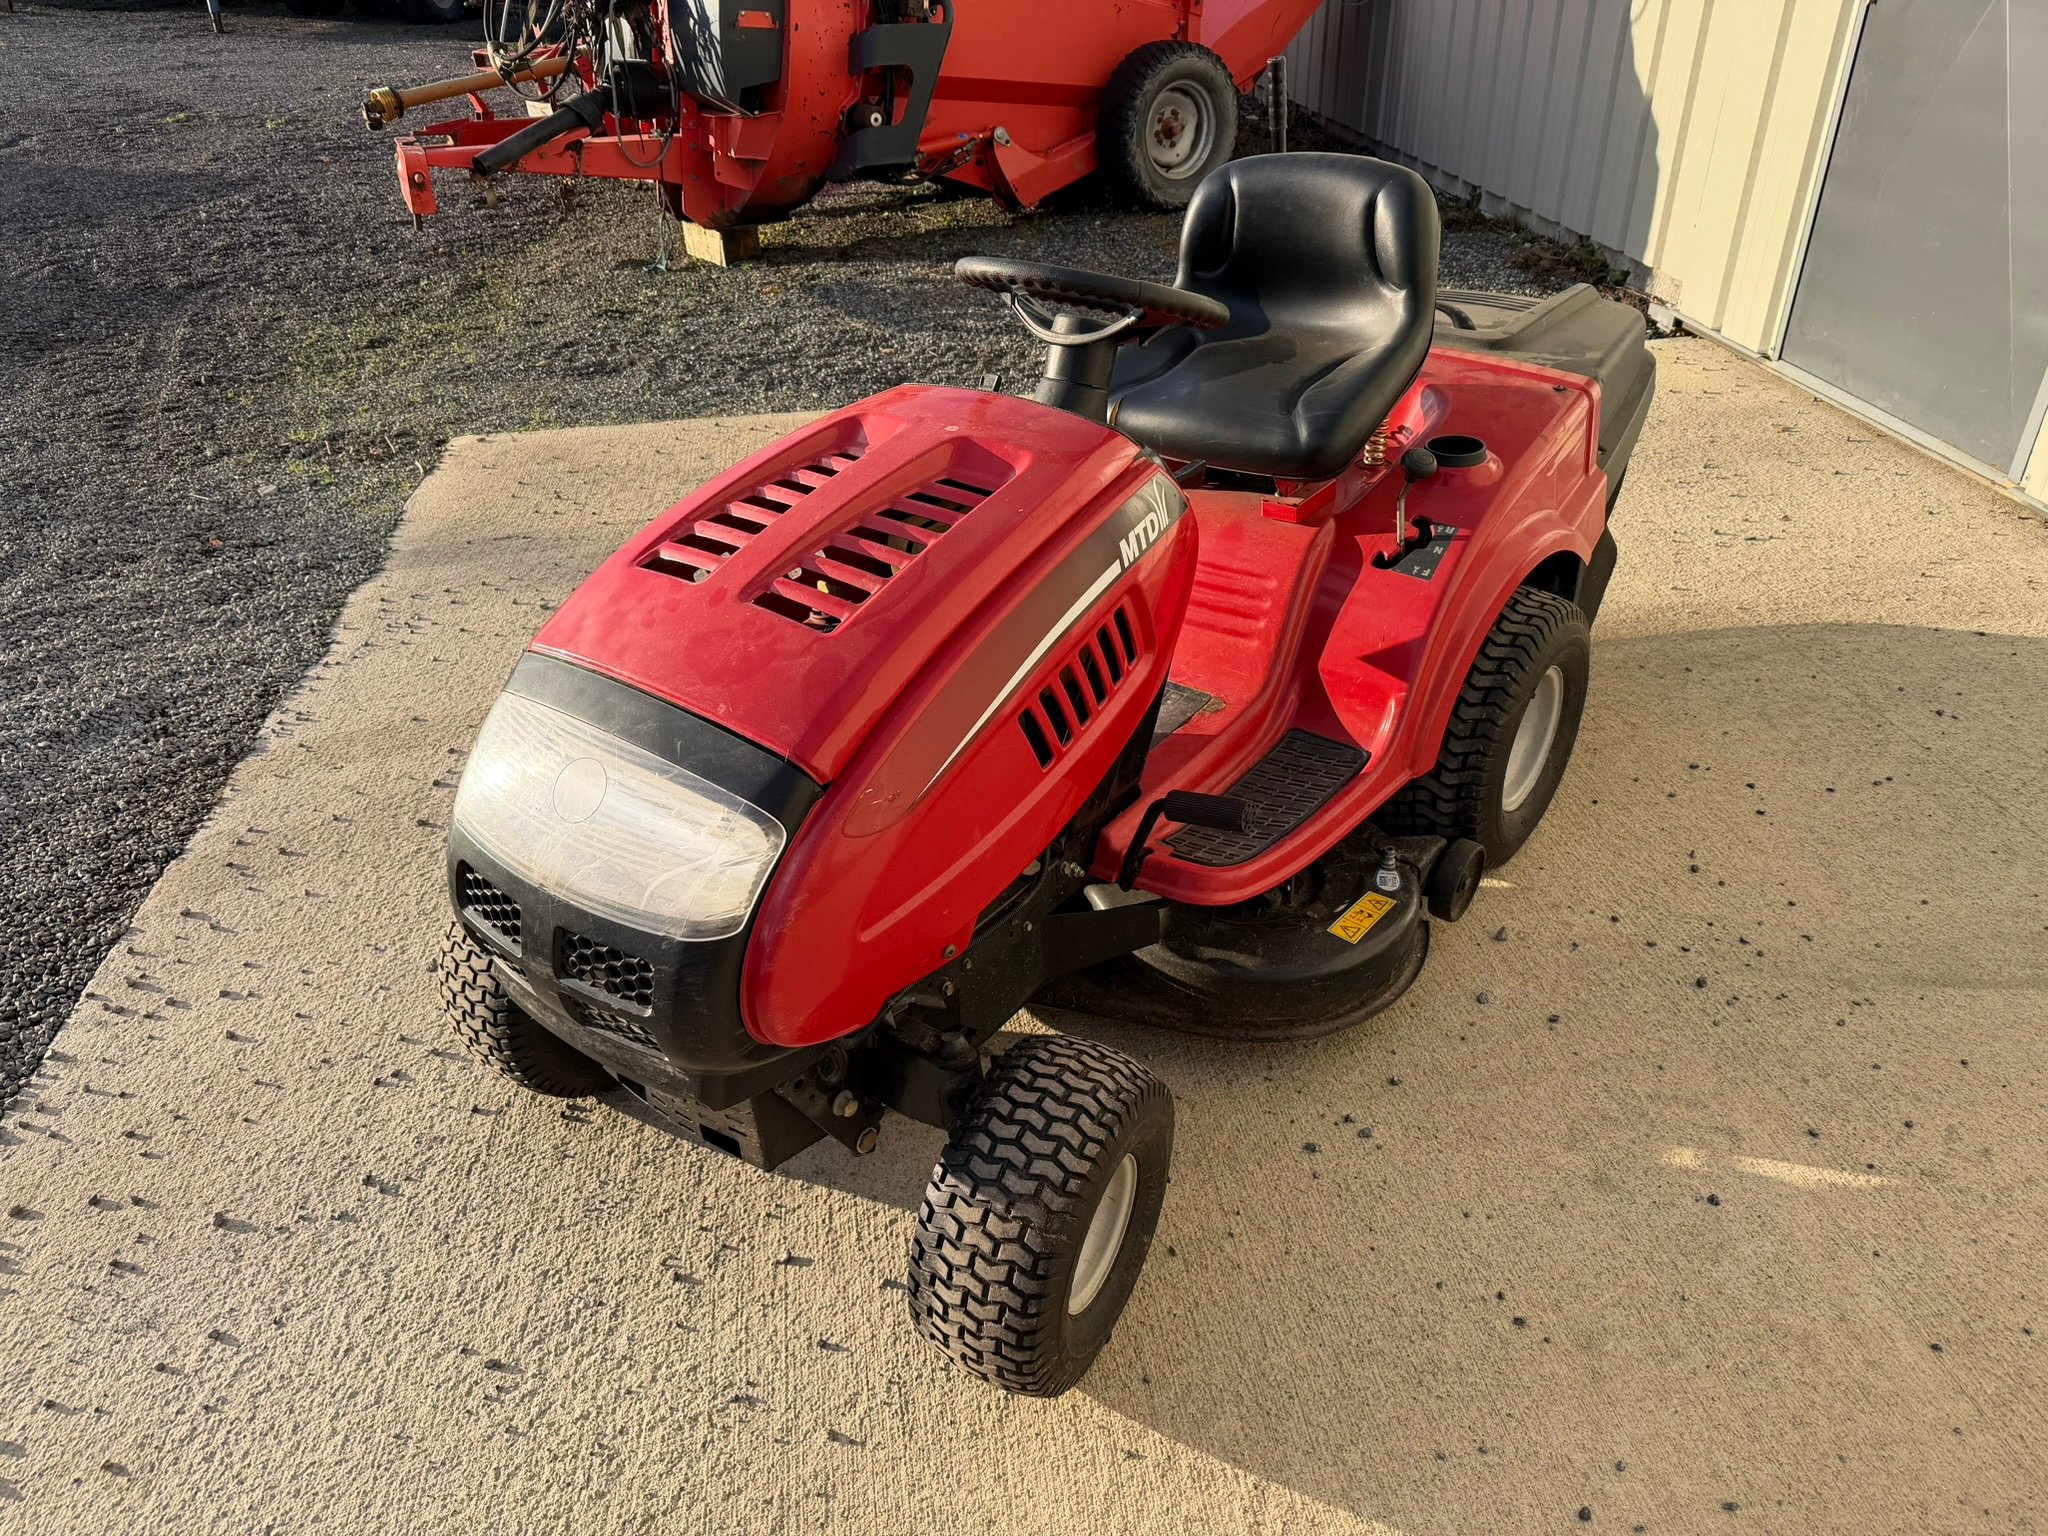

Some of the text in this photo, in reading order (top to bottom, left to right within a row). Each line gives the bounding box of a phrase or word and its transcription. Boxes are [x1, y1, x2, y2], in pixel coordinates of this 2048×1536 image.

[1445, 526, 1455, 534] R
[1119, 512, 1160, 569] MTD
[1433, 546, 1443, 555] N
[1421, 568, 1431, 577] F
